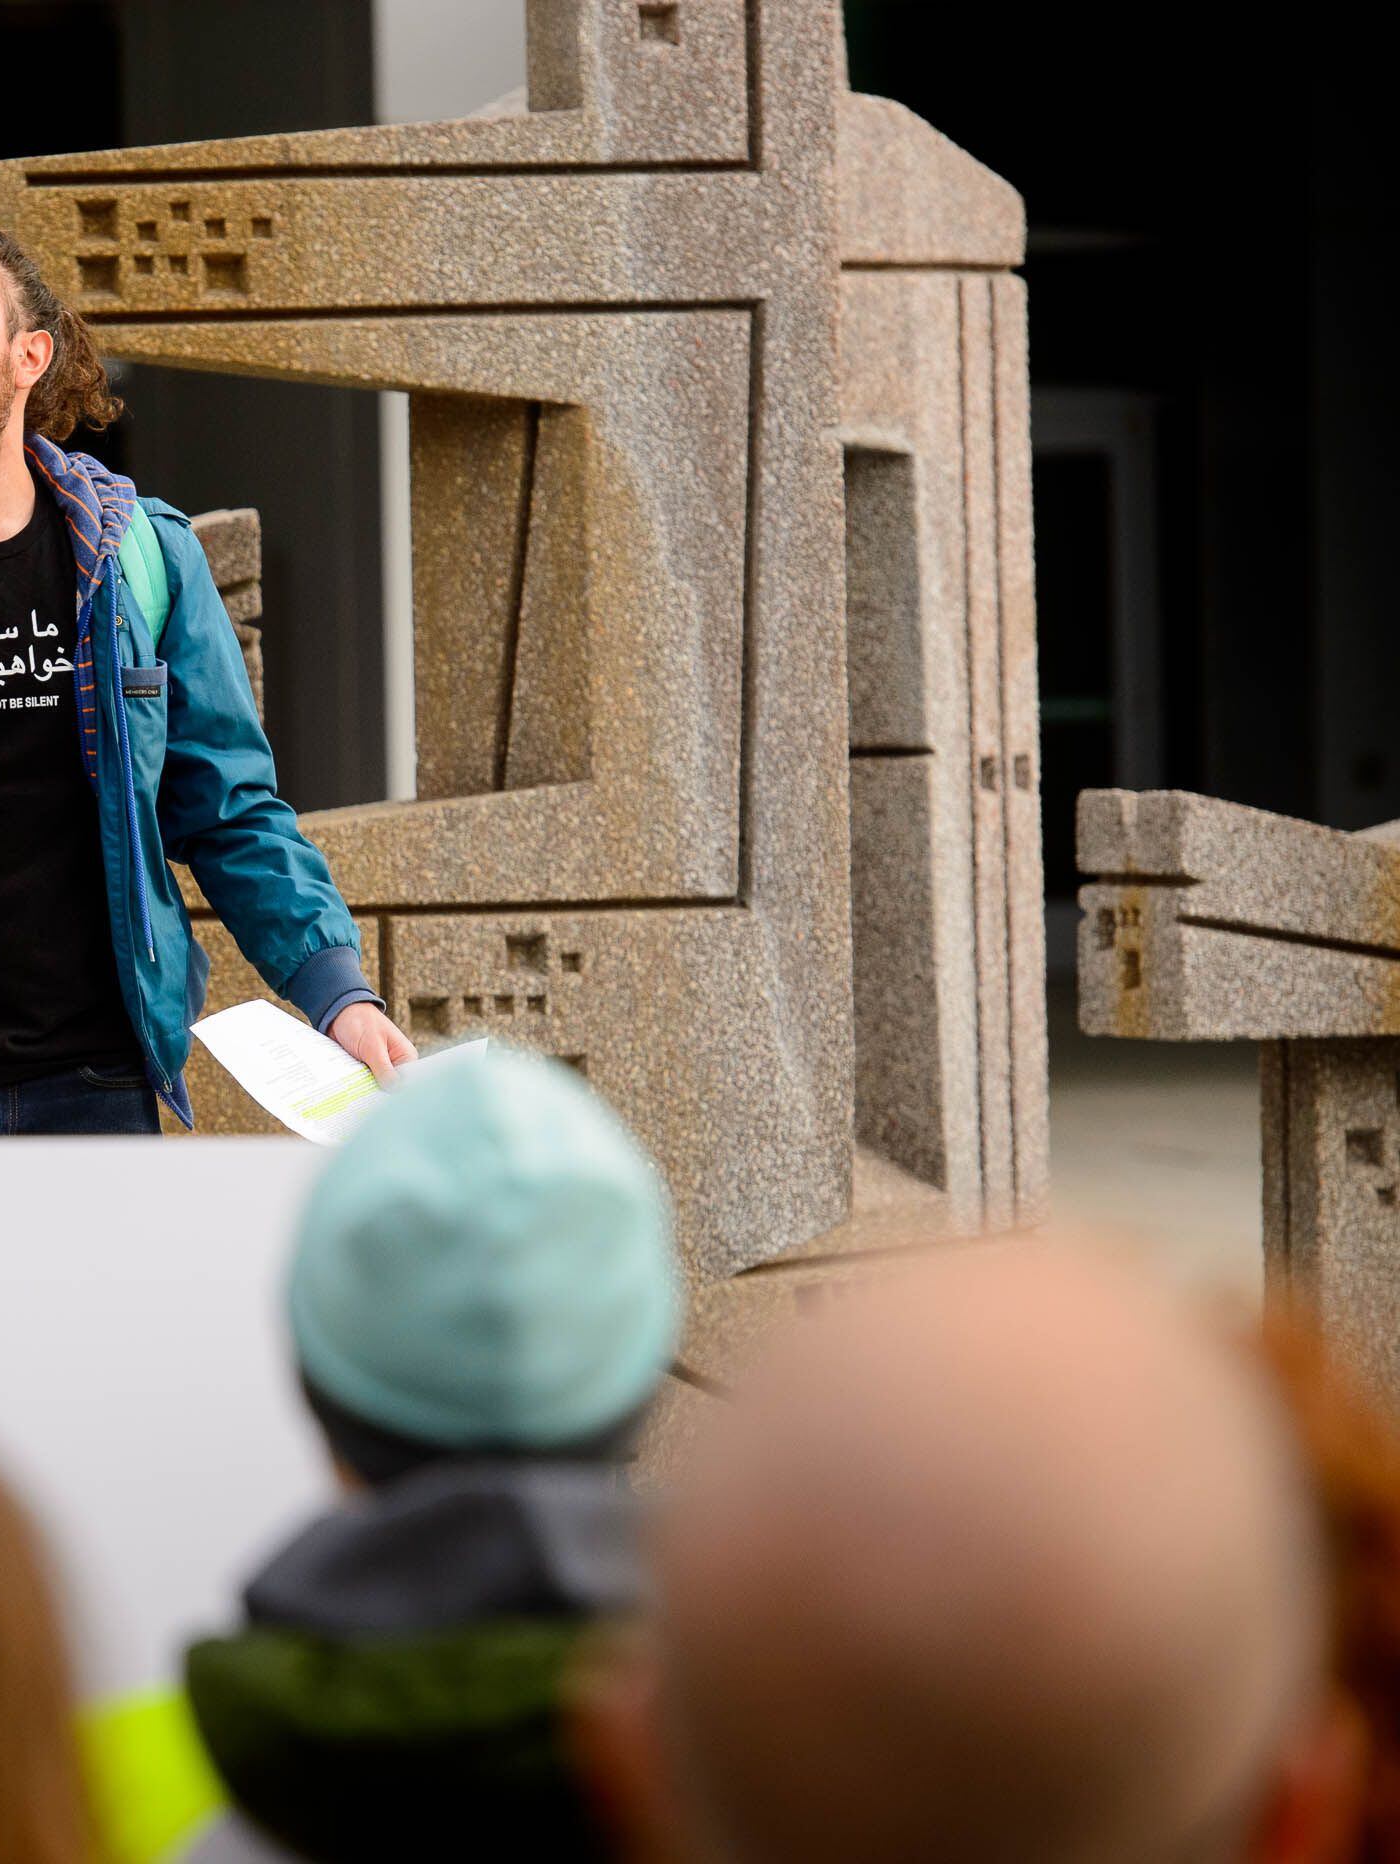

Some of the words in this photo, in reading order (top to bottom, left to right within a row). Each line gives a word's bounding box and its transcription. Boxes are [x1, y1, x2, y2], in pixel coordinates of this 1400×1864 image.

[31, 608, 59, 638] ما
[9, 697, 24, 709] BE
[25, 695, 60, 708] SILENT
